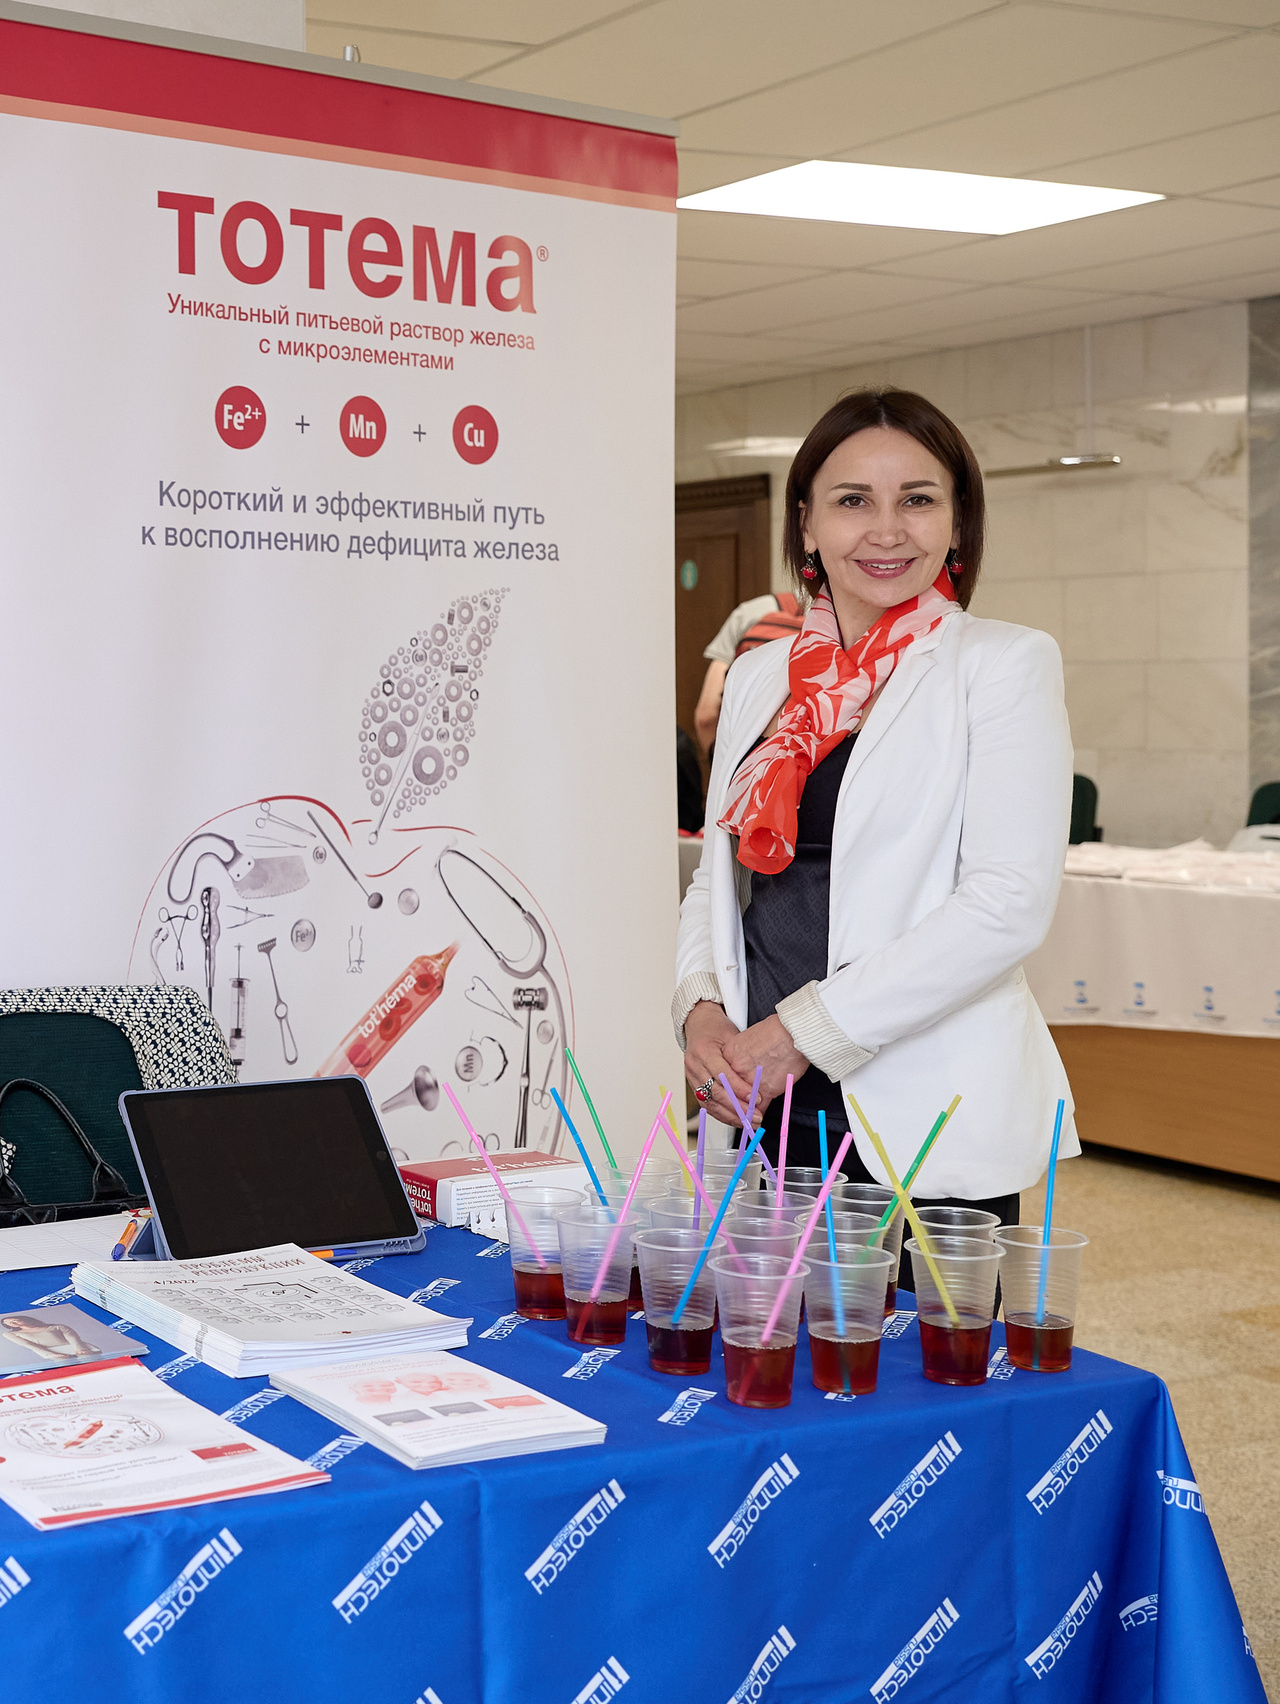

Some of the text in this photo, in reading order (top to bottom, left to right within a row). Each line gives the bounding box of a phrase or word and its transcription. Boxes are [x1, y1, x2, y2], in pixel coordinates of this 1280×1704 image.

[167, 292, 535, 351] Уникальный питьевой раствор железа
[259, 337, 454, 371] с микроэлементами
[349, 413, 377, 440] Mn
[463, 422, 485, 447] Cu
[159, 480, 545, 530] Короткий и эффективный путь
[141, 526, 560, 562] к восполнению дефицита железа
[463, 1053, 474, 1073] Mn
[179, 1254, 266, 1271] ПРОБЛЕМЫ
[191, 1258, 306, 1278] РЕПРОДУКЦИИ
[894, 1469, 919, 1498] russia
